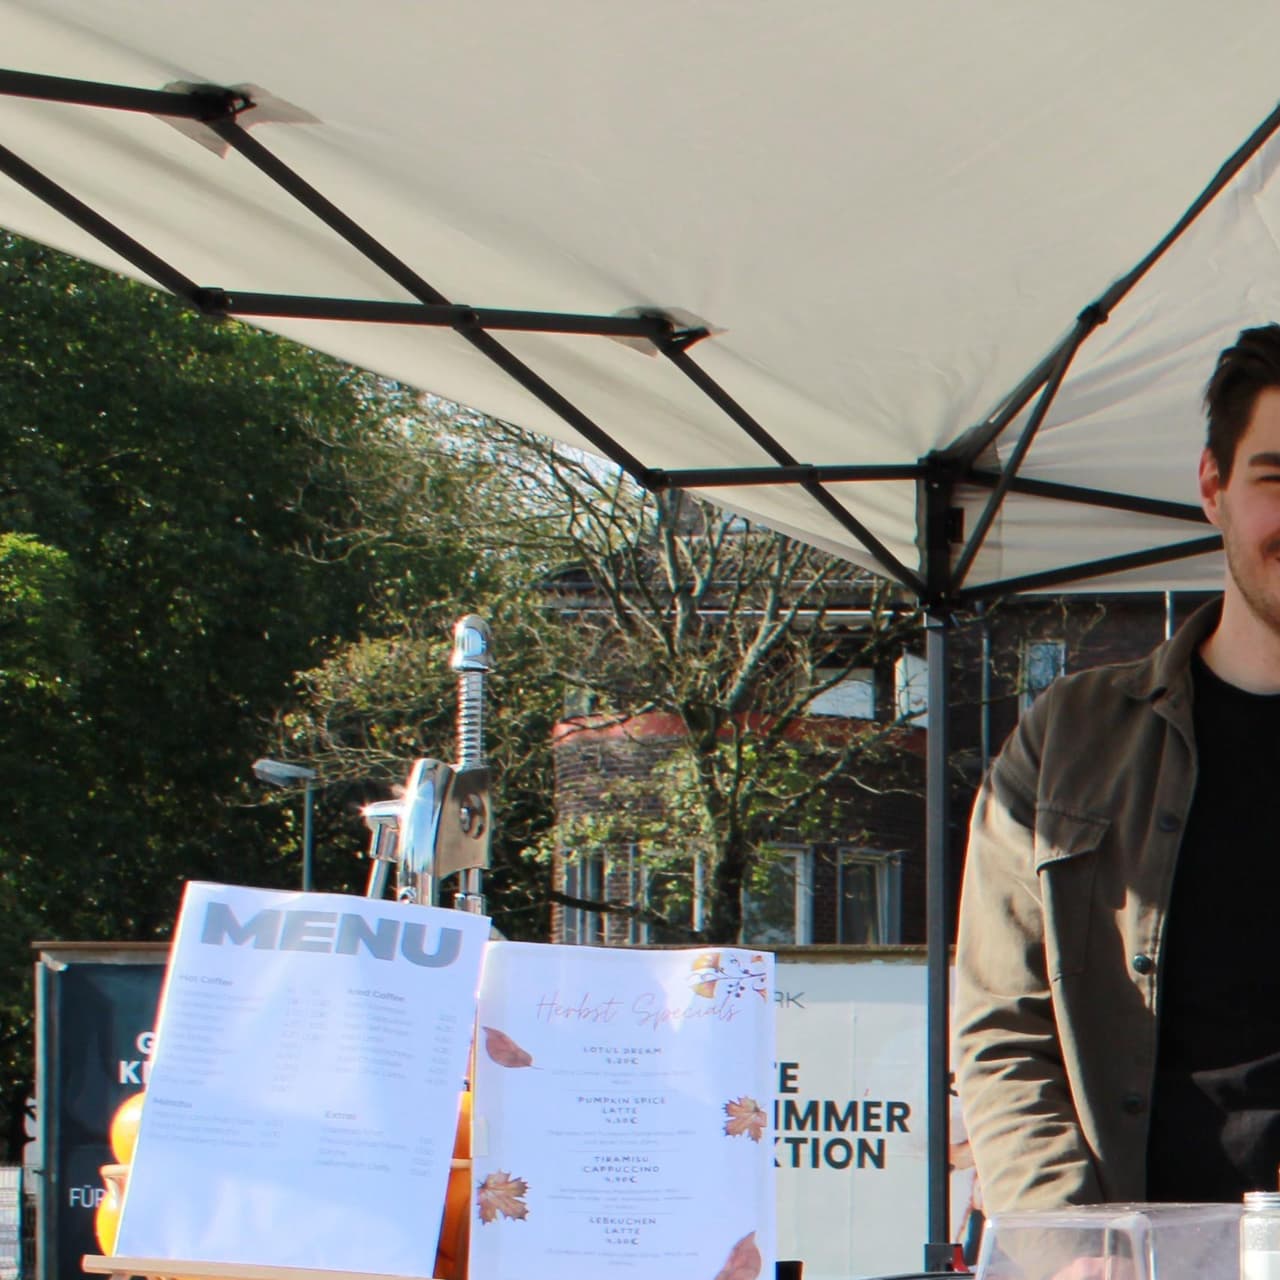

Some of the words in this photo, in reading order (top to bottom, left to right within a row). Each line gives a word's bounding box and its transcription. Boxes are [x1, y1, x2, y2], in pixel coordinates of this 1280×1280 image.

[200, 902, 463, 967] MENU
[372, 989, 406, 1003] Coffee
[536, 991, 624, 1025] Herbst
[631, 991, 745, 1030] Specials
[623, 1046, 663, 1055] DREAM
[775, 1062, 800, 1093] E
[577, 1096, 630, 1104] PUMPKIN
[634, 1096, 666, 1104] SPICE
[593, 1155, 649, 1163] TIRAMISU
[583, 1165, 660, 1173] CAPPUCCINO
[589, 1216, 657, 1225] LEBKUCHEN
